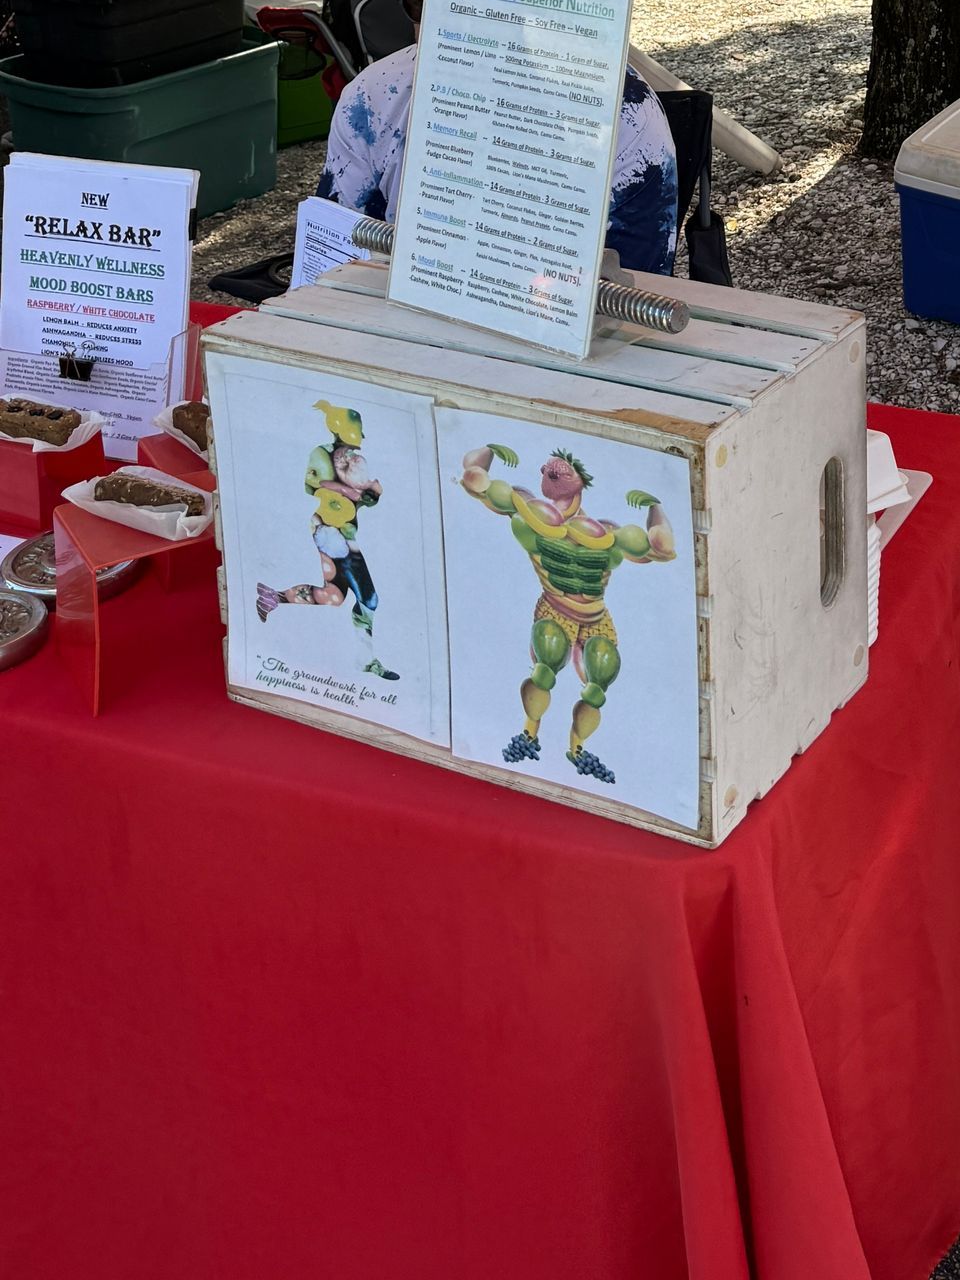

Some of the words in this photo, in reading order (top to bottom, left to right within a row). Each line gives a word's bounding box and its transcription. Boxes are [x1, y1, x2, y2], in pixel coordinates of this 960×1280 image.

[450, 2, 477, 15] Organic
[485, 8, 509, 20] Gluten
[510, 13, 526, 24] Free
[535, 18, 548, 29] Soy
[550, 20, 566, 30] Free
[575, 24, 598, 38] Vegan
[569, 91, 581, 101] (NO
[473, 93, 486, 103] Chip
[497, 98, 505, 106] 16
[506, 102, 521, 112] Grams
[529, 106, 548, 116] Protein
[561, 113, 577, 122] Grams
[433, 123, 458, 136] Memory
[459, 128, 478, 139] Recall
[429, 167, 484, 187] Anti-Inflammation
[490, 181, 498, 190] 14
[499, 185, 515, 195] Grams
[523, 190, 541, 201] Protein
[551, 198, 567, 208] Grams
[81, 192, 110, 208] NEW
[307, 221, 341, 240] Nutrition
[423, 208, 448, 220] Immune
[449, 214, 466, 226] Boost
[475, 221, 483, 230] 14
[484, 225, 500, 235] Grams
[507, 231, 525, 242] Protein
[539, 240, 555, 250] Grams
[20, 248, 93, 268] HEAVENLY
[96, 255, 165, 277] WELLNESS
[418, 255, 435, 267] Mood
[436, 260, 453, 271] Boost
[543, 267, 557, 279] (NO
[29, 276, 67, 291] MOOD
[70, 281, 113, 298] BOOST
[116, 288, 154, 303] BARS
[27, 298, 76, 312] RASPBERRY
[82, 305, 106, 316] WHITE
[108, 310, 155, 322] CHOCOLATE
[42, 316, 62, 325] LEMON
[86, 322, 112, 331] REDUCES
[114, 325, 137, 334] ANXIETY
[42, 328, 86, 338] ASHWAGANDHA
[95, 334, 120, 343] REDUCES
[122, 337, 142, 345] STRESS
[41, 349, 59, 357] LION'S
[115, 358, 134, 367] MOOD
[256, 670, 306, 691] happiness
[311, 685, 320, 696] is
[293, 668, 357, 693] groundwork
[358, 686, 377, 702] for
[380, 694, 397, 706] all
